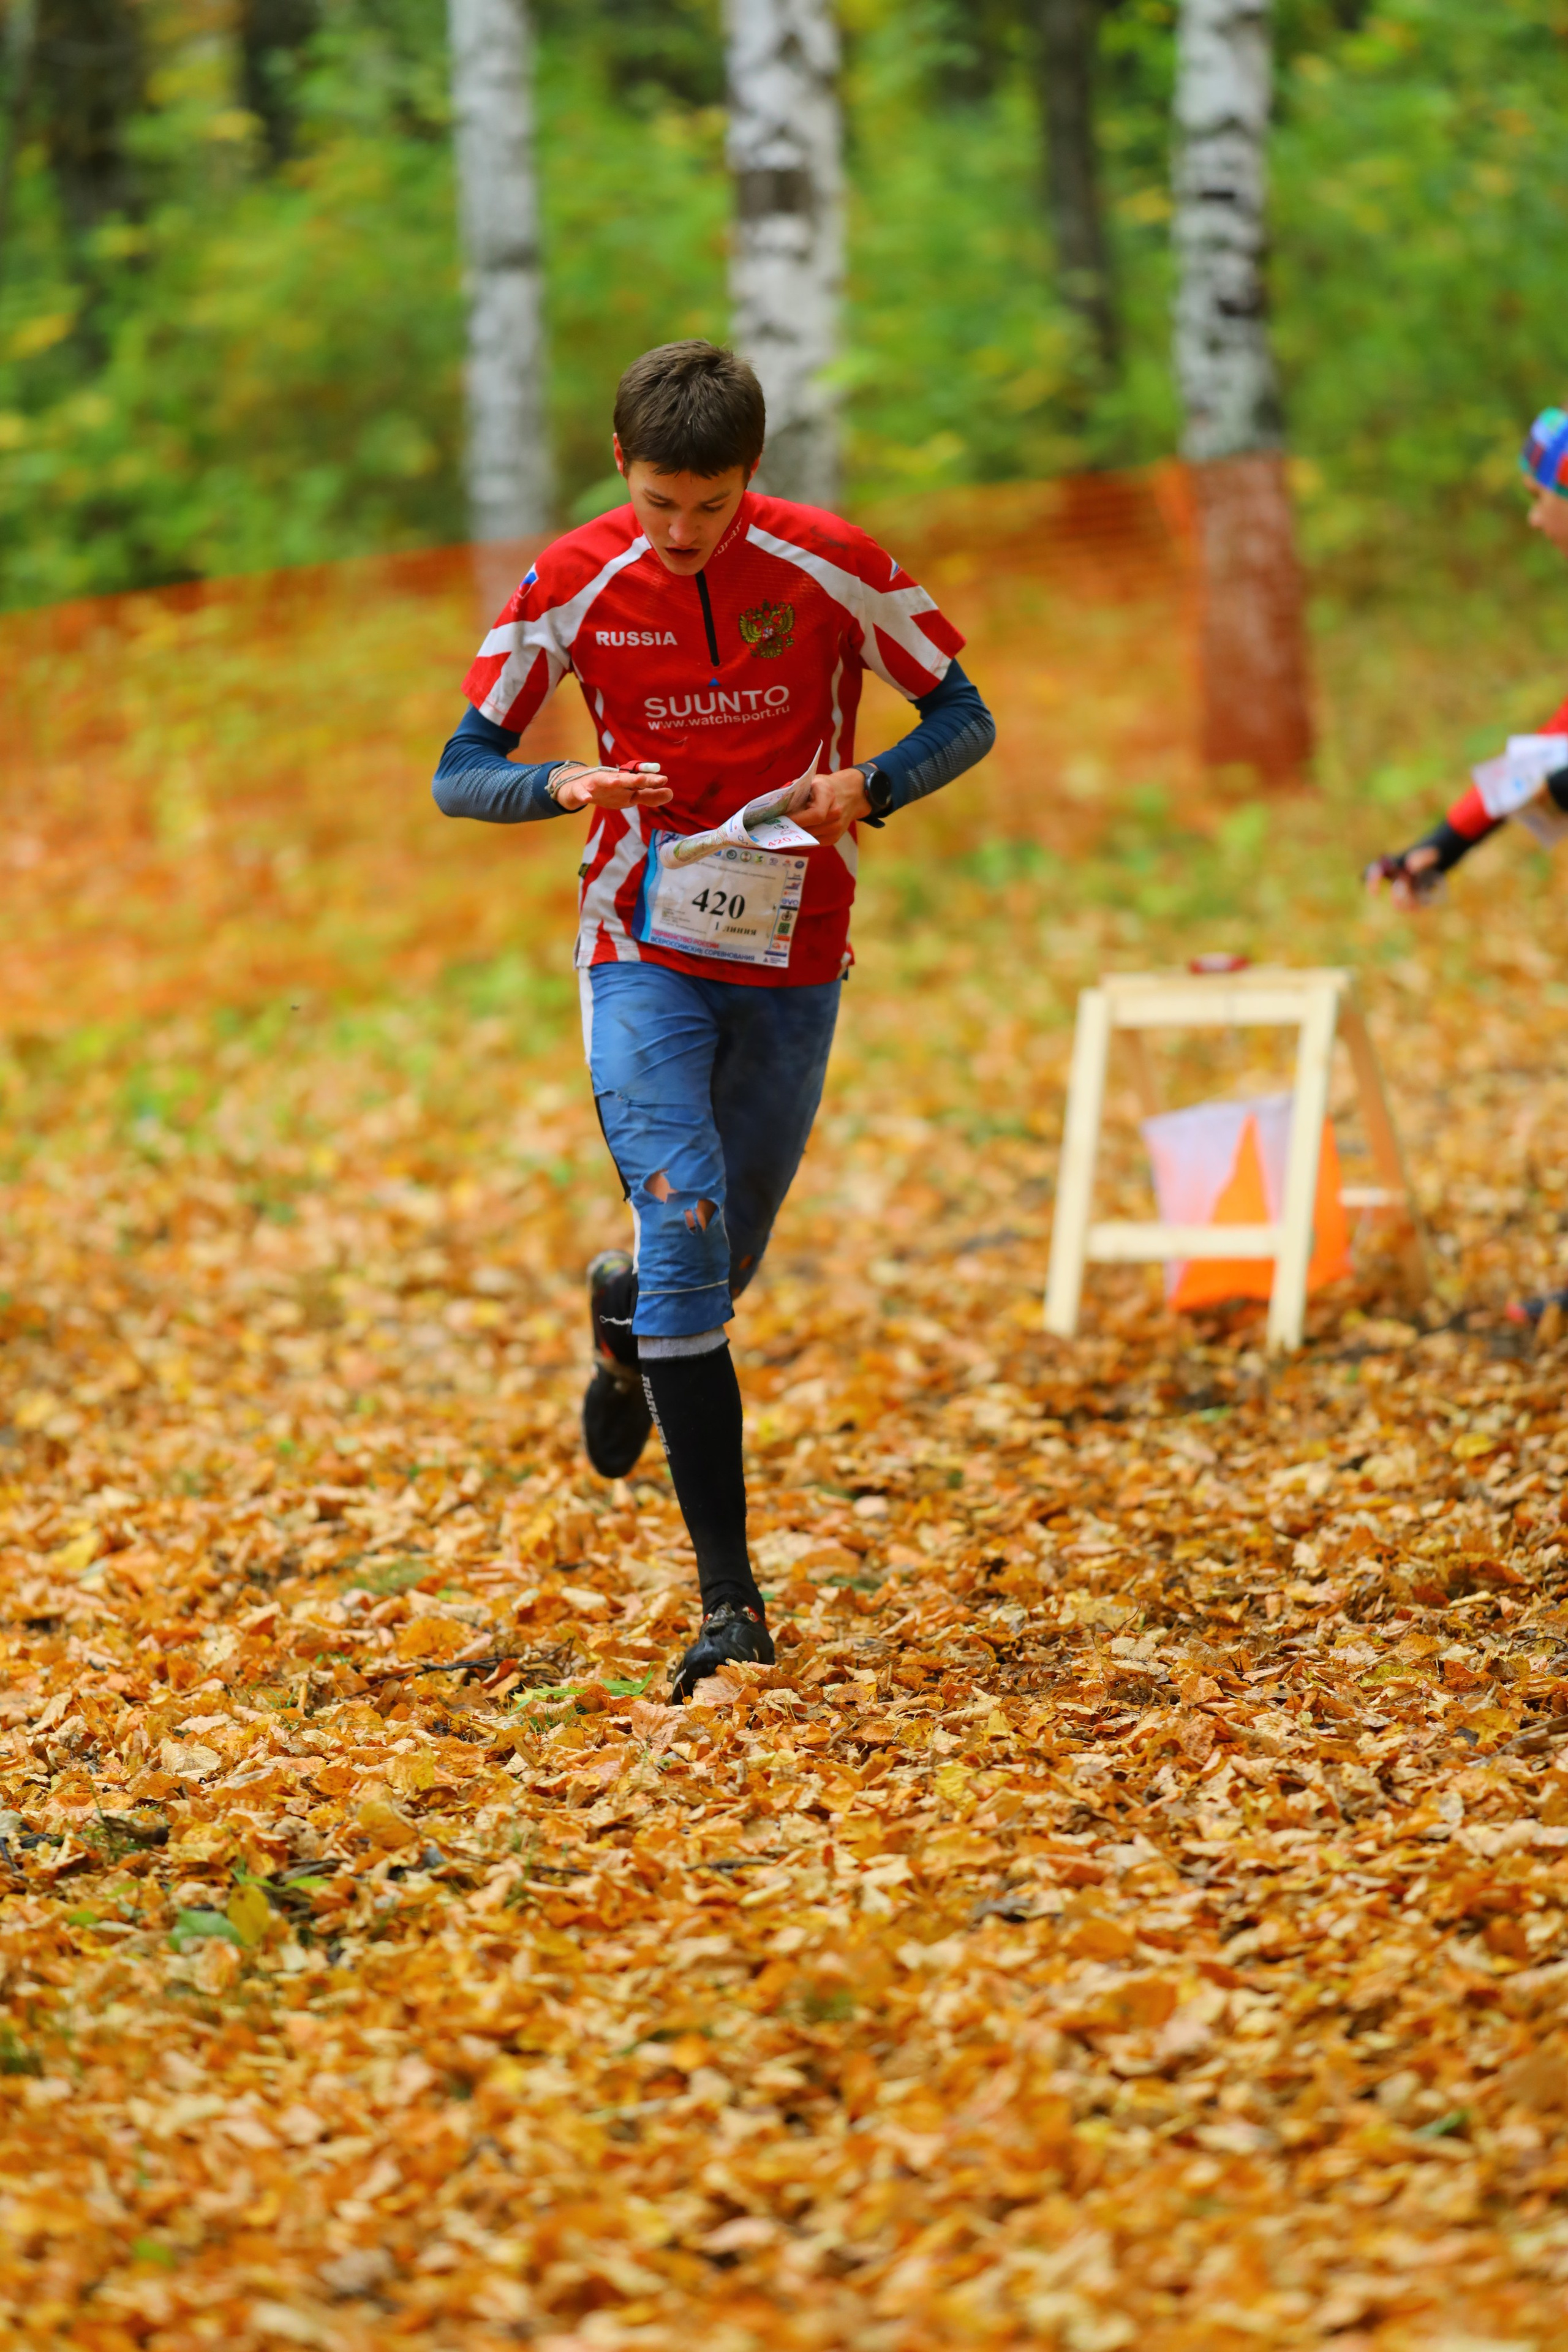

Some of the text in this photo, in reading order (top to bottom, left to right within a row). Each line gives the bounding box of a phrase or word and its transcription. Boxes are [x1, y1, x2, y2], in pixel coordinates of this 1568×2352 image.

[596, 631, 677, 646] RUSSIA
[644, 685, 790, 718] SUUNTO
[648, 706, 790, 731] www.watchsport.ru
[692, 888, 745, 919] 420
[704, 948, 755, 962] СОРЕВНОВАНИЯ
